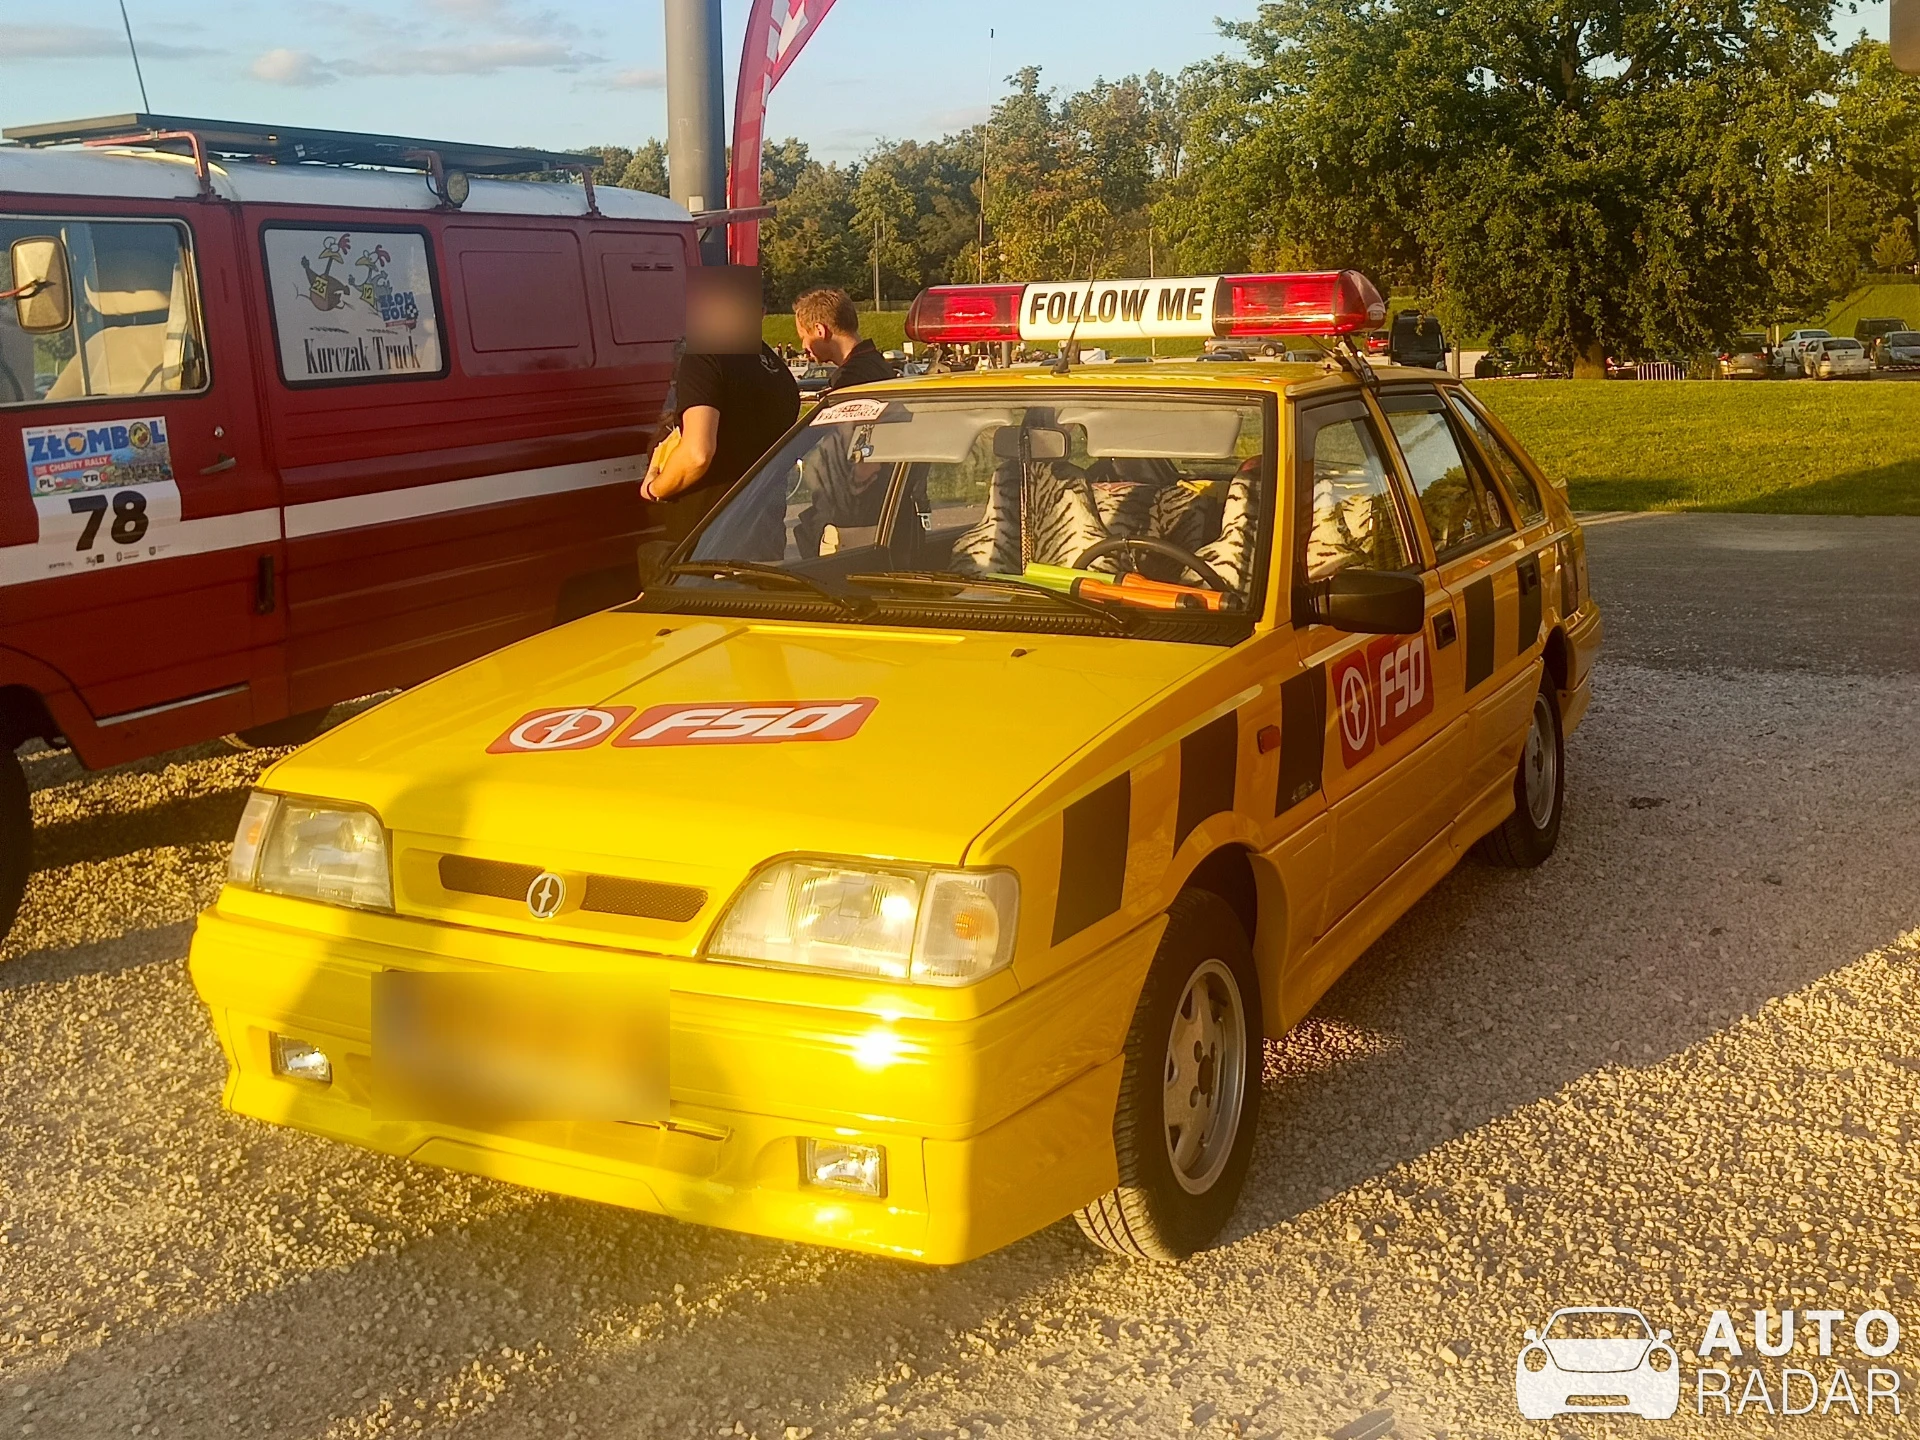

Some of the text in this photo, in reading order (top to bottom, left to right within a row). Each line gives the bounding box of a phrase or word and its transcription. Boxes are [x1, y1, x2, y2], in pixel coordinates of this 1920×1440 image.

[363, 287, 373, 299] 12
[1029, 287, 1206, 324] FOLLOW ME
[304, 336, 421, 374] Kurczak Truck
[28, 420, 166, 462] ZŁOMBOL
[49, 461, 83, 472] CHARITY
[84, 456, 108, 467] RALLY
[83, 473, 99, 483] TR
[39, 479, 54, 489] PL
[68, 490, 150, 551] 78
[1380, 635, 1425, 728] FSO
[629, 703, 864, 741] FSO
